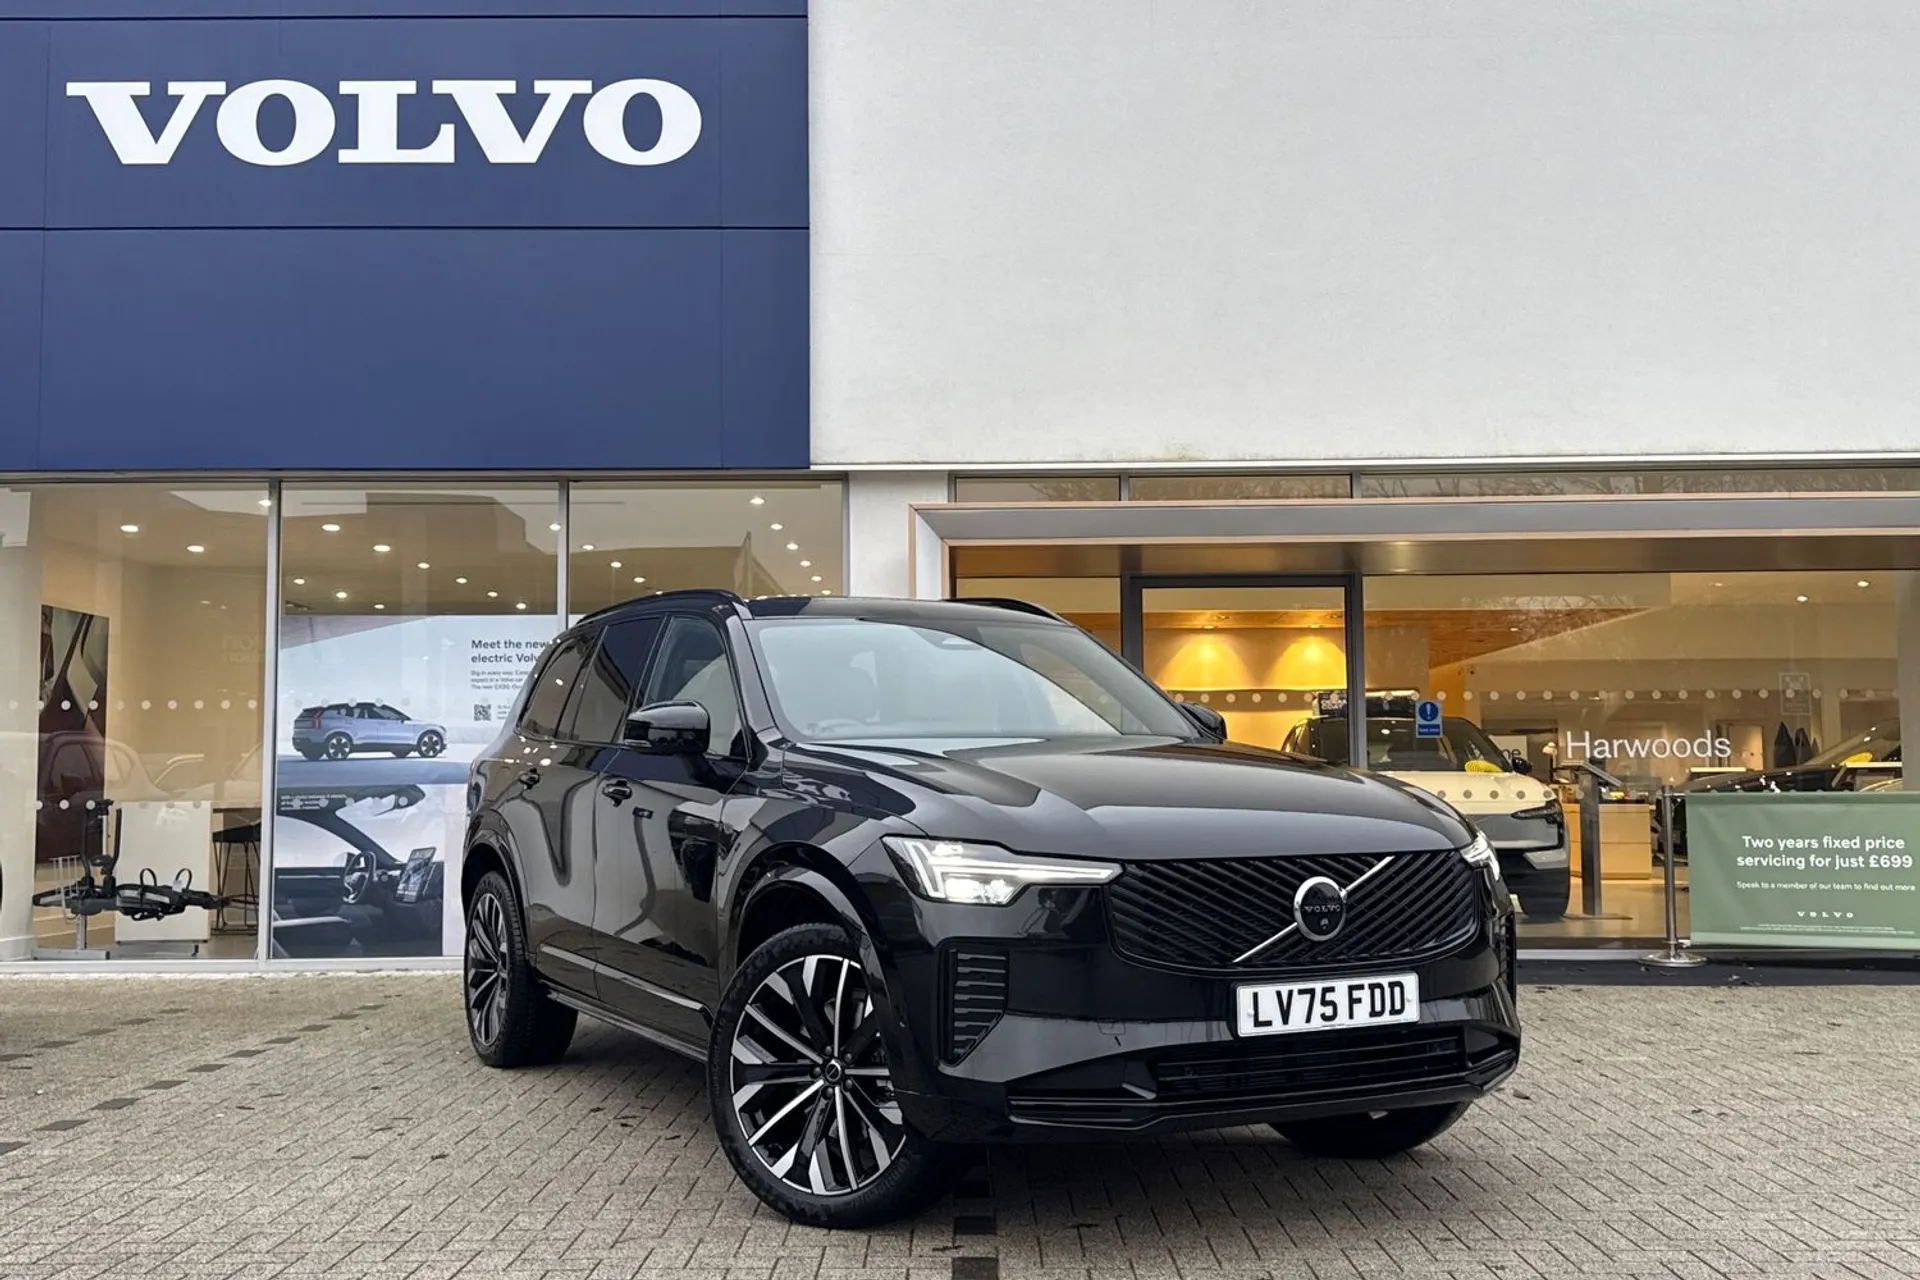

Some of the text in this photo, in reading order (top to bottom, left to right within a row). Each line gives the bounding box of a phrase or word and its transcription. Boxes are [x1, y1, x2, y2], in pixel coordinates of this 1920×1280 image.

[66, 78, 702, 166] VOLVO
[471, 640, 500, 649] Meet
[504, 640, 522, 649] the
[471, 653, 513, 663] electric
[1566, 729, 1731, 759] Harwoods
[1742, 835, 1905, 851] Two years fixed price
[1736, 854, 1913, 870] servicing for just £699
[1737, 881, 1760, 889] Speak
[1761, 881, 1769, 889] to
[1777, 881, 1808, 889] member
[1809, 881, 1818, 889] of
[1832, 882, 1853, 890] team
[1854, 882, 1862, 890] to
[1863, 882, 1879, 891] find
[1880, 883, 1894, 891] out
[1304, 904, 1341, 913] VOLVO
[1252, 980, 1405, 1027] LV75 FDD
